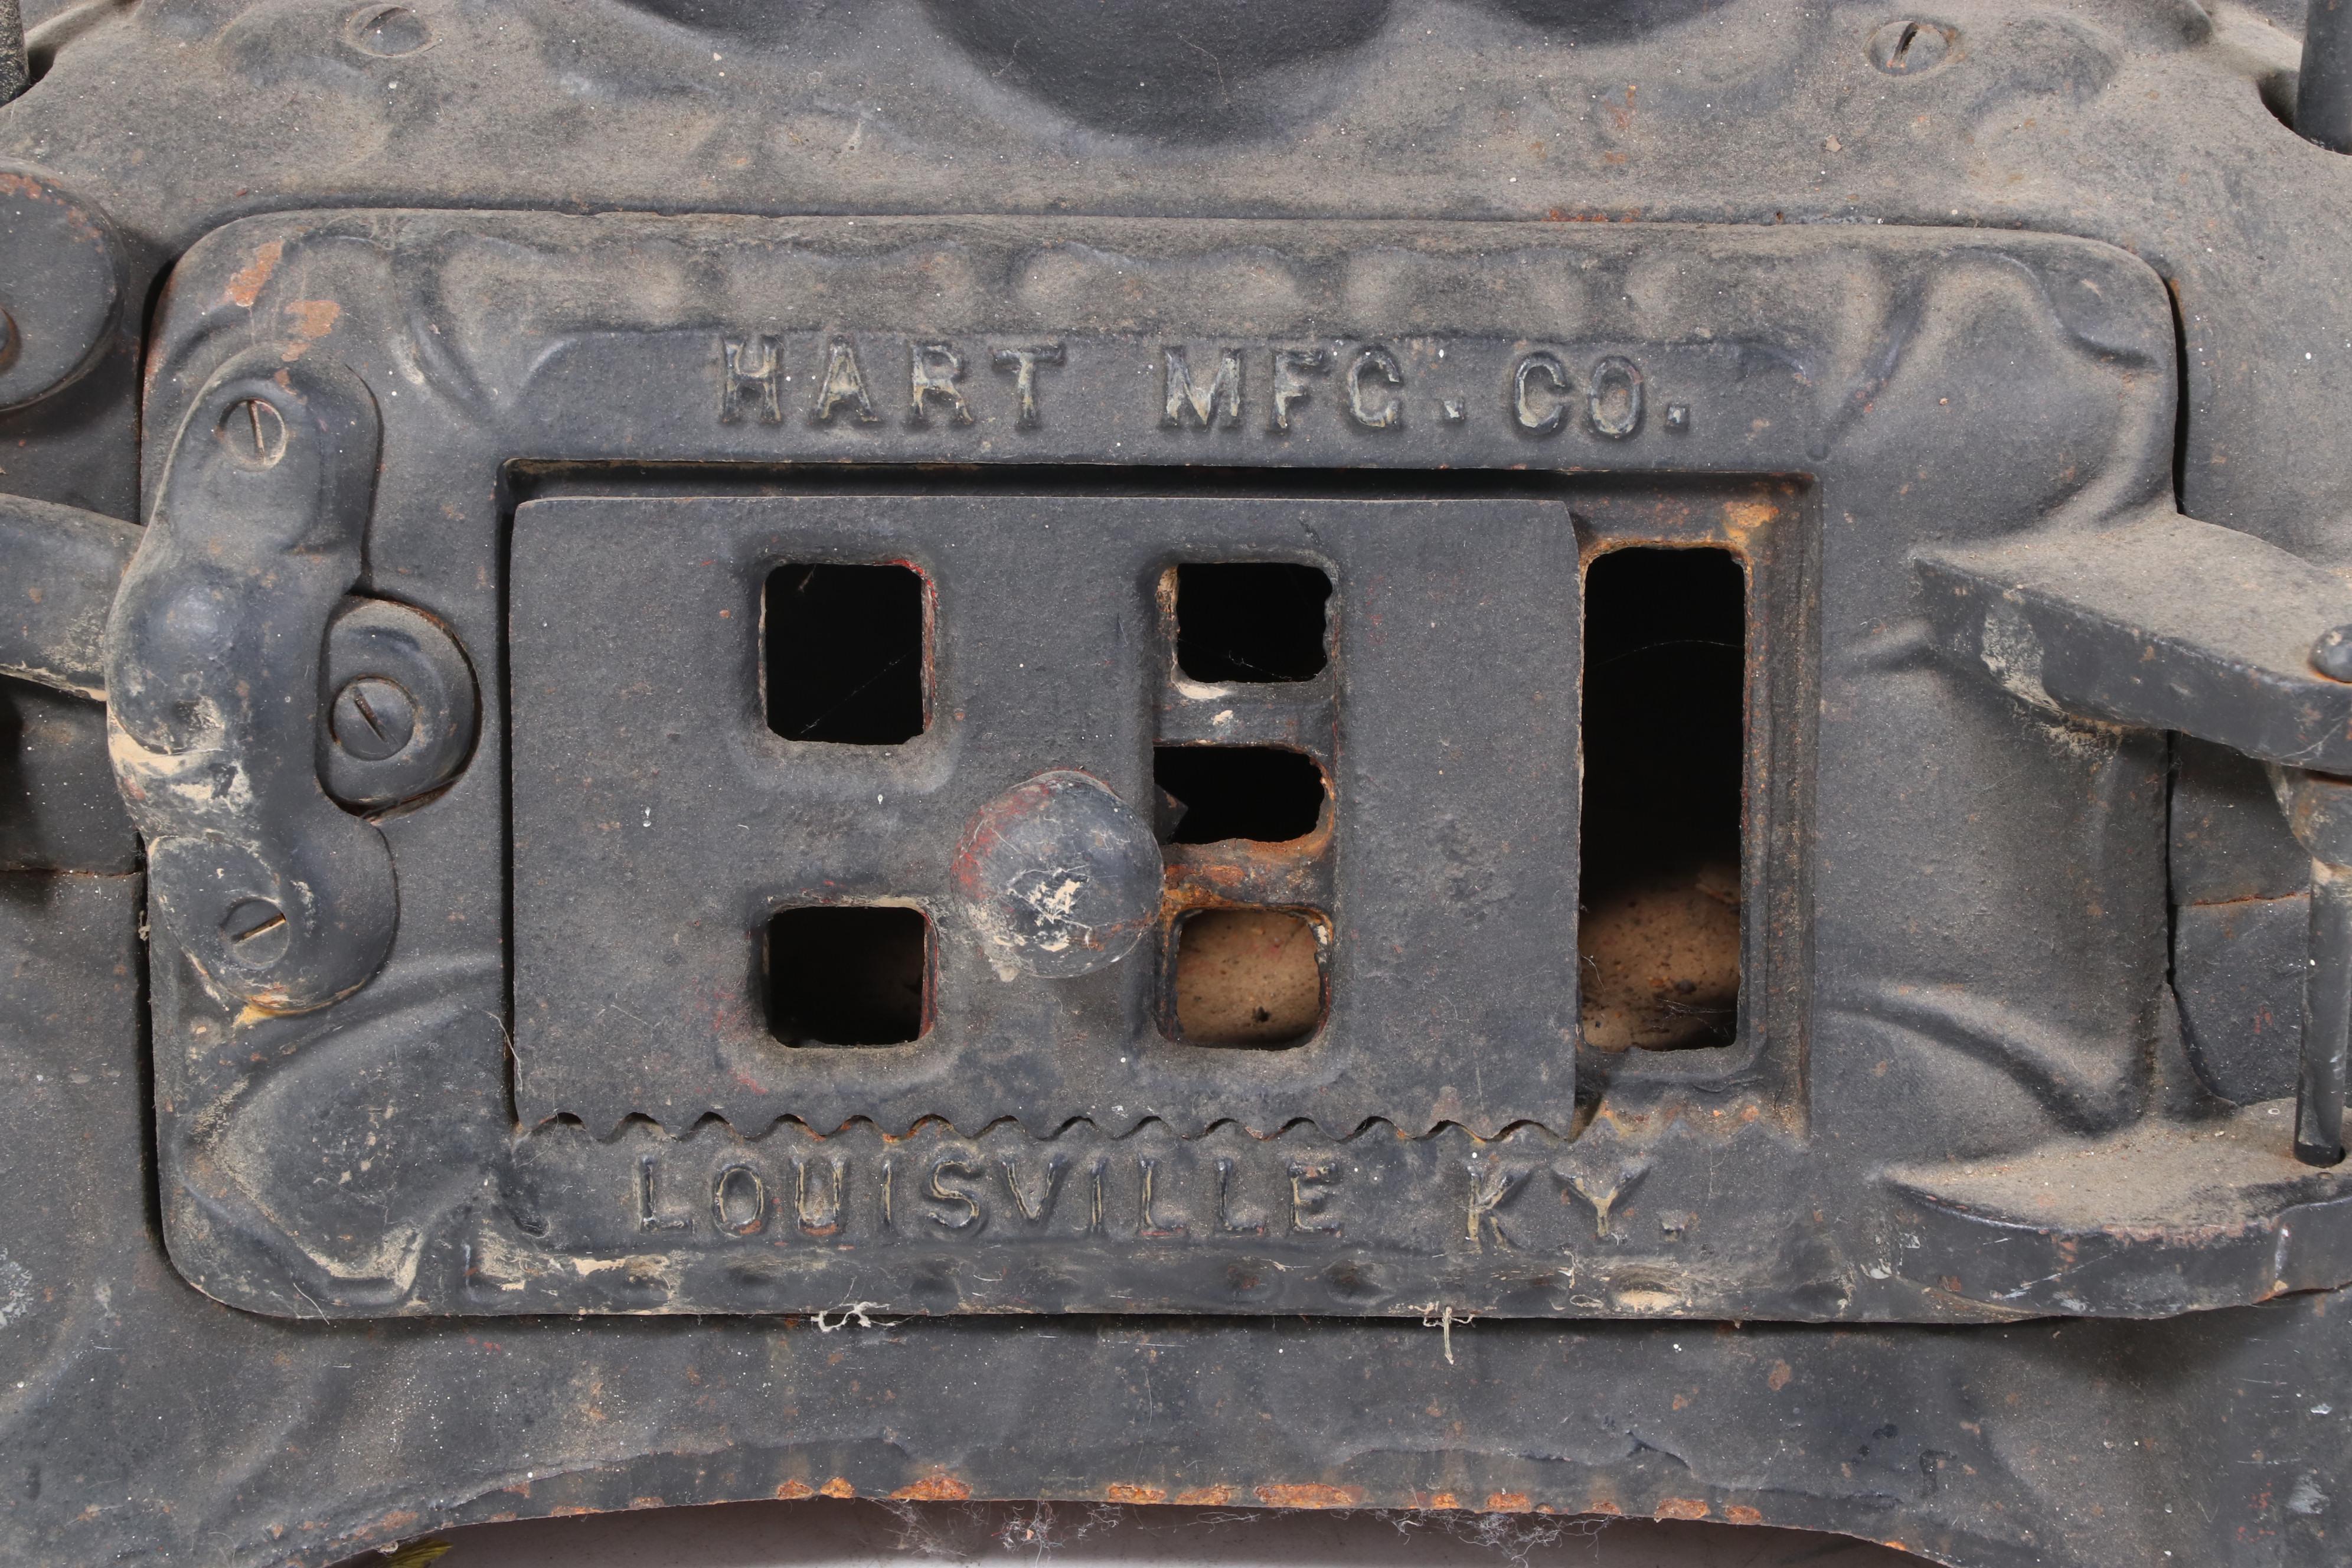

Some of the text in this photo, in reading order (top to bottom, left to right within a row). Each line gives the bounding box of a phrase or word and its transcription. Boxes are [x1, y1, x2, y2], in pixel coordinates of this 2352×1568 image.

[719, 335, 1065, 430] HART
[1514, 353, 1691, 438] CO.
[635, 1154, 1344, 1239] LOUISVILLE
